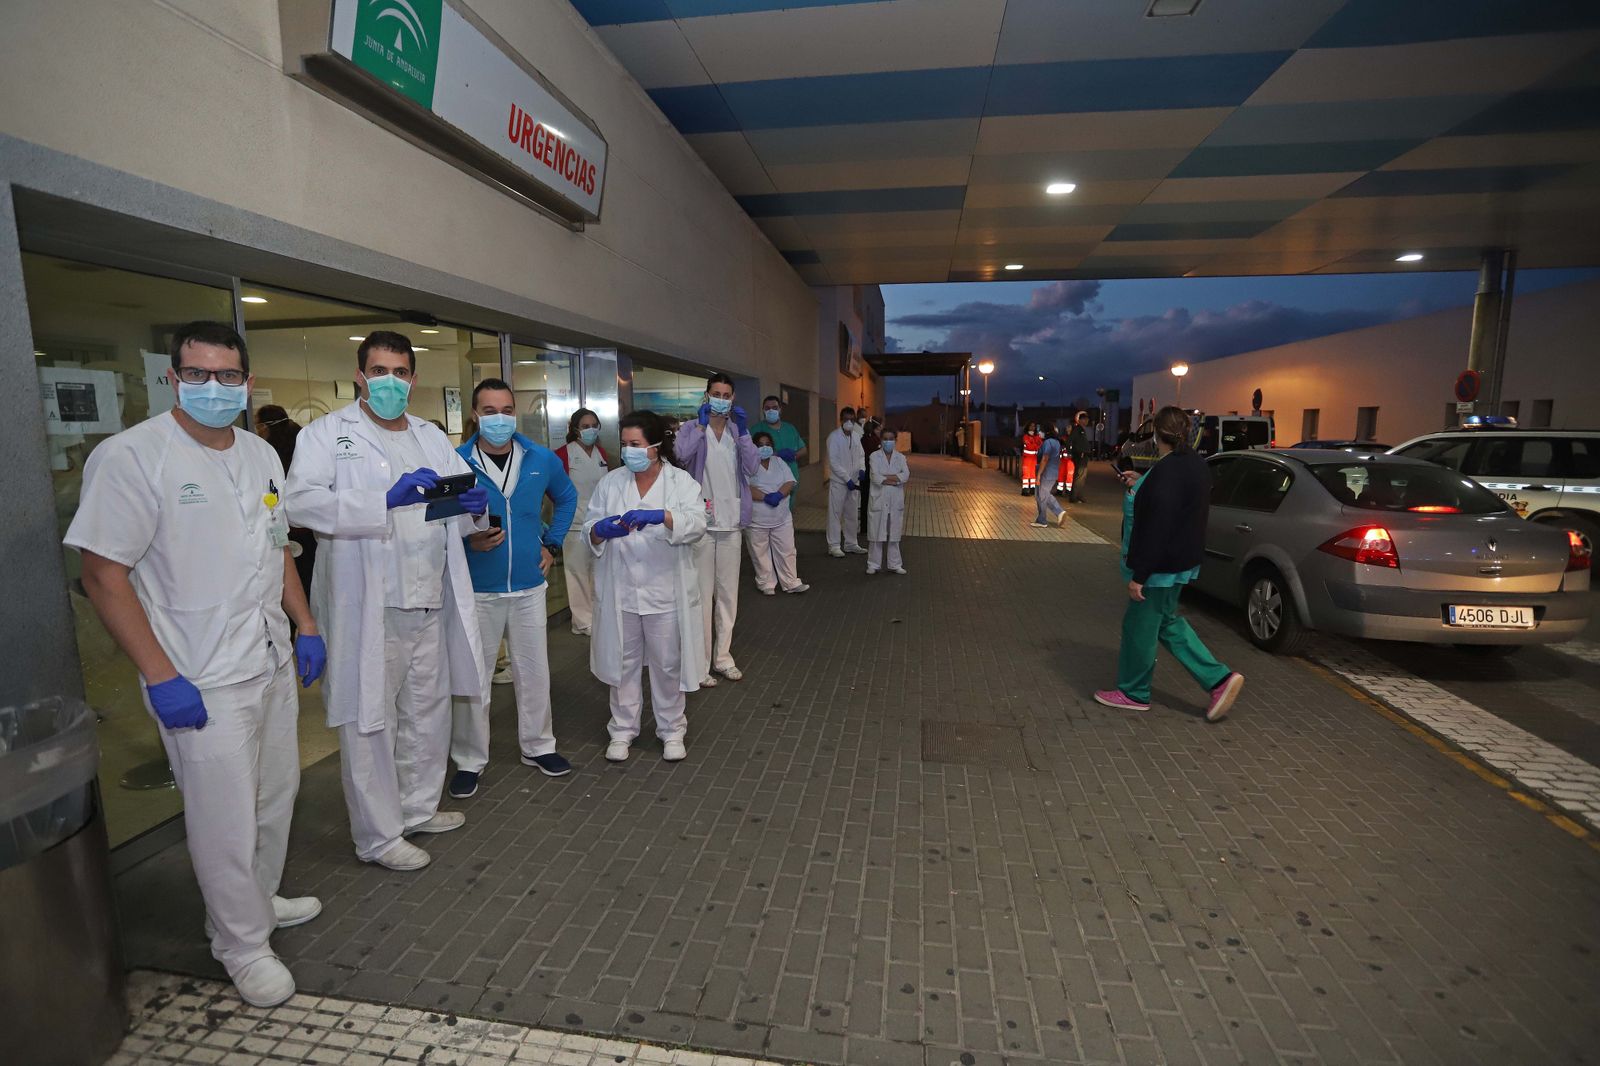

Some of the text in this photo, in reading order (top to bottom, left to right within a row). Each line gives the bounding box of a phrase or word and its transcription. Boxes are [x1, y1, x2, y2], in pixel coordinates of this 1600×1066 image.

[363, 34, 385, 57] JUNTA
[386, 49, 395, 64] DE
[508, 102, 596, 196] URGENCIAS
[156, 375, 169, 385] AT
[1458, 608, 1529, 624] 4506 DJL
